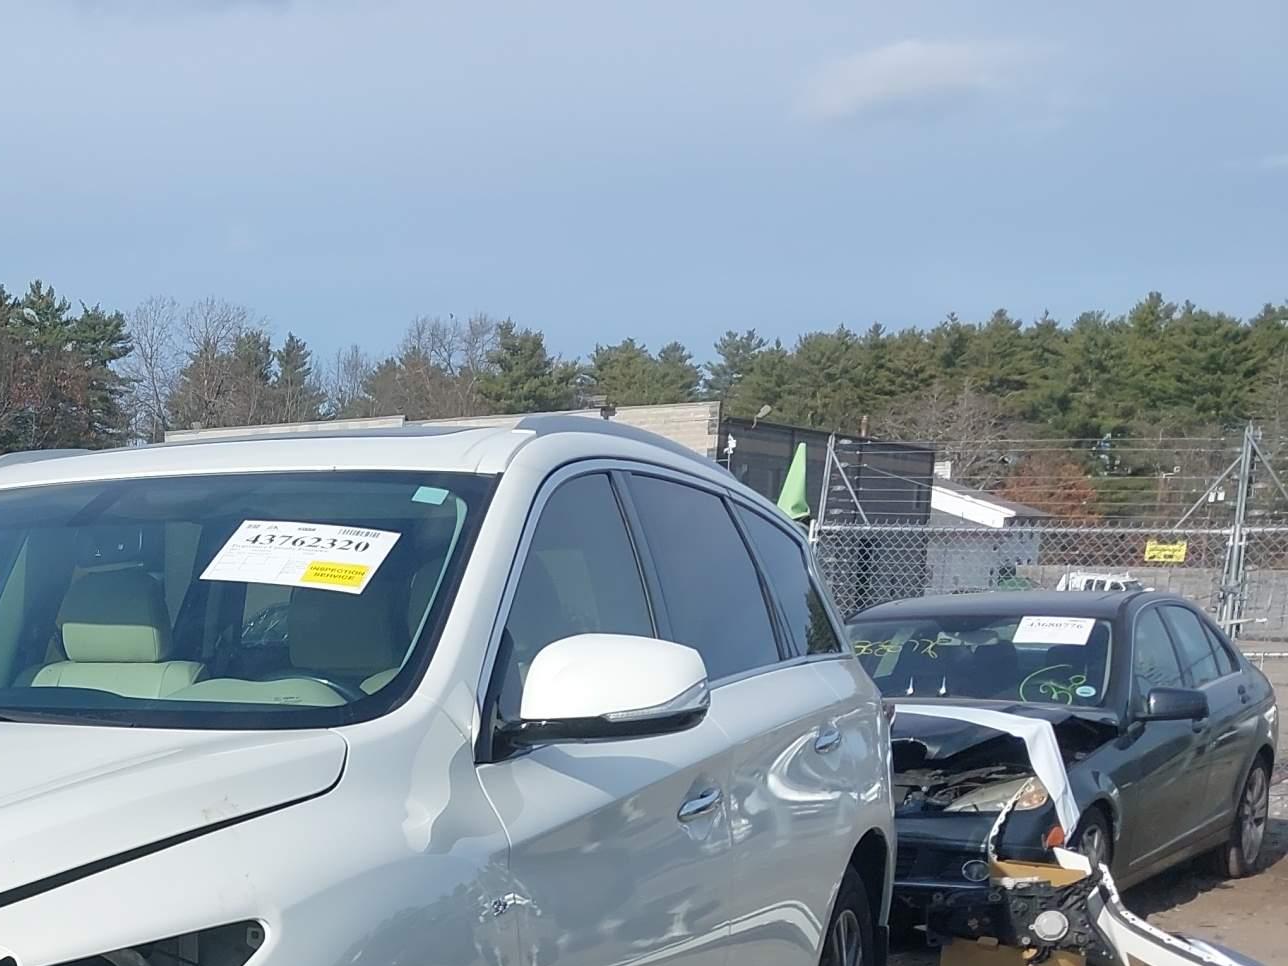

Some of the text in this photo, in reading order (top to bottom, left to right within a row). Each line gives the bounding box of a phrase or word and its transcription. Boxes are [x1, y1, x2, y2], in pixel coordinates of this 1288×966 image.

[245, 534, 371, 553] 43762320
[309, 565, 366, 577] INSPECTION
[313, 571, 355, 581] SERVICE
